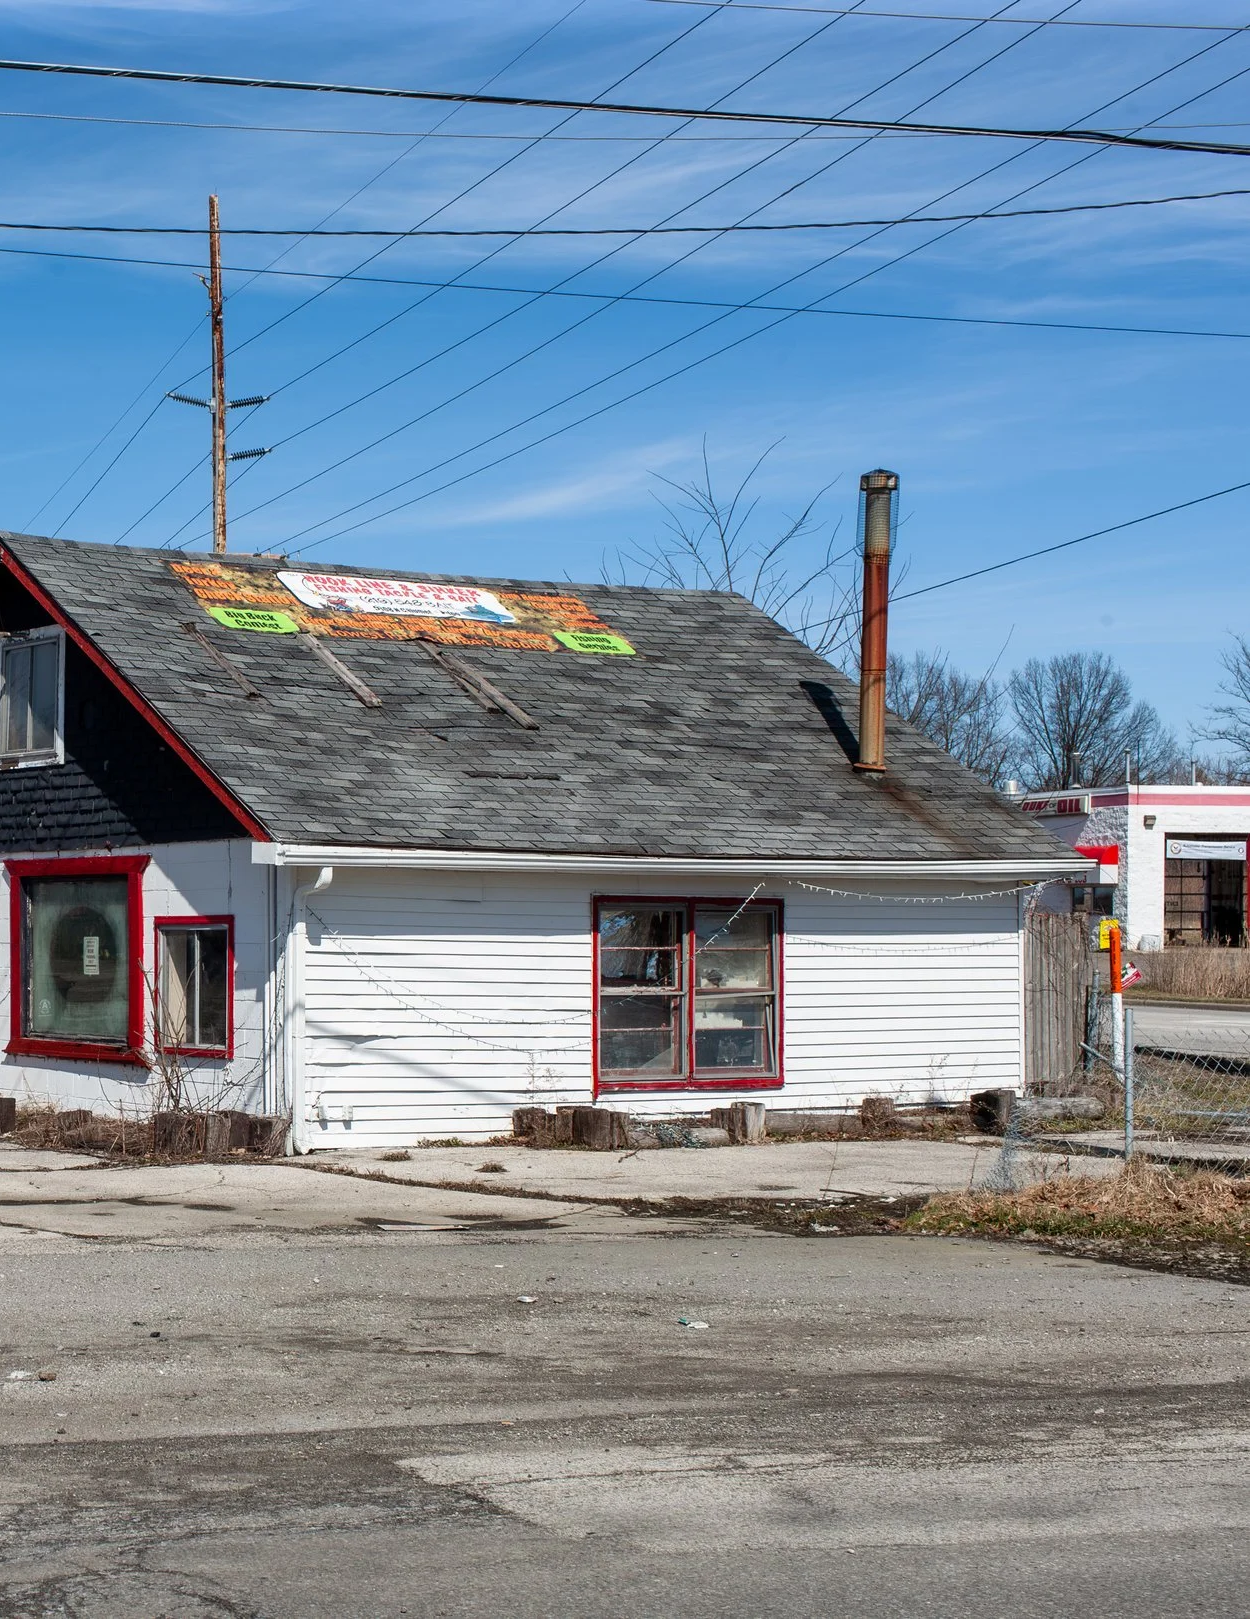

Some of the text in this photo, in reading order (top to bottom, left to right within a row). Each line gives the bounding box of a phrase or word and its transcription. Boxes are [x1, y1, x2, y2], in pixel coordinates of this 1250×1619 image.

[304, 575, 481, 597] HOOK LINE & SINKER
[313, 584, 373, 595] FISHING
[377, 589, 429, 600] TACKLE
[448, 594, 479, 603] BAIT
[224, 610, 277, 621] Big Buck
[234, 619, 283, 630] Contest
[570, 635, 611, 644] Fishing
[1057, 798, 1081, 813] OIL
